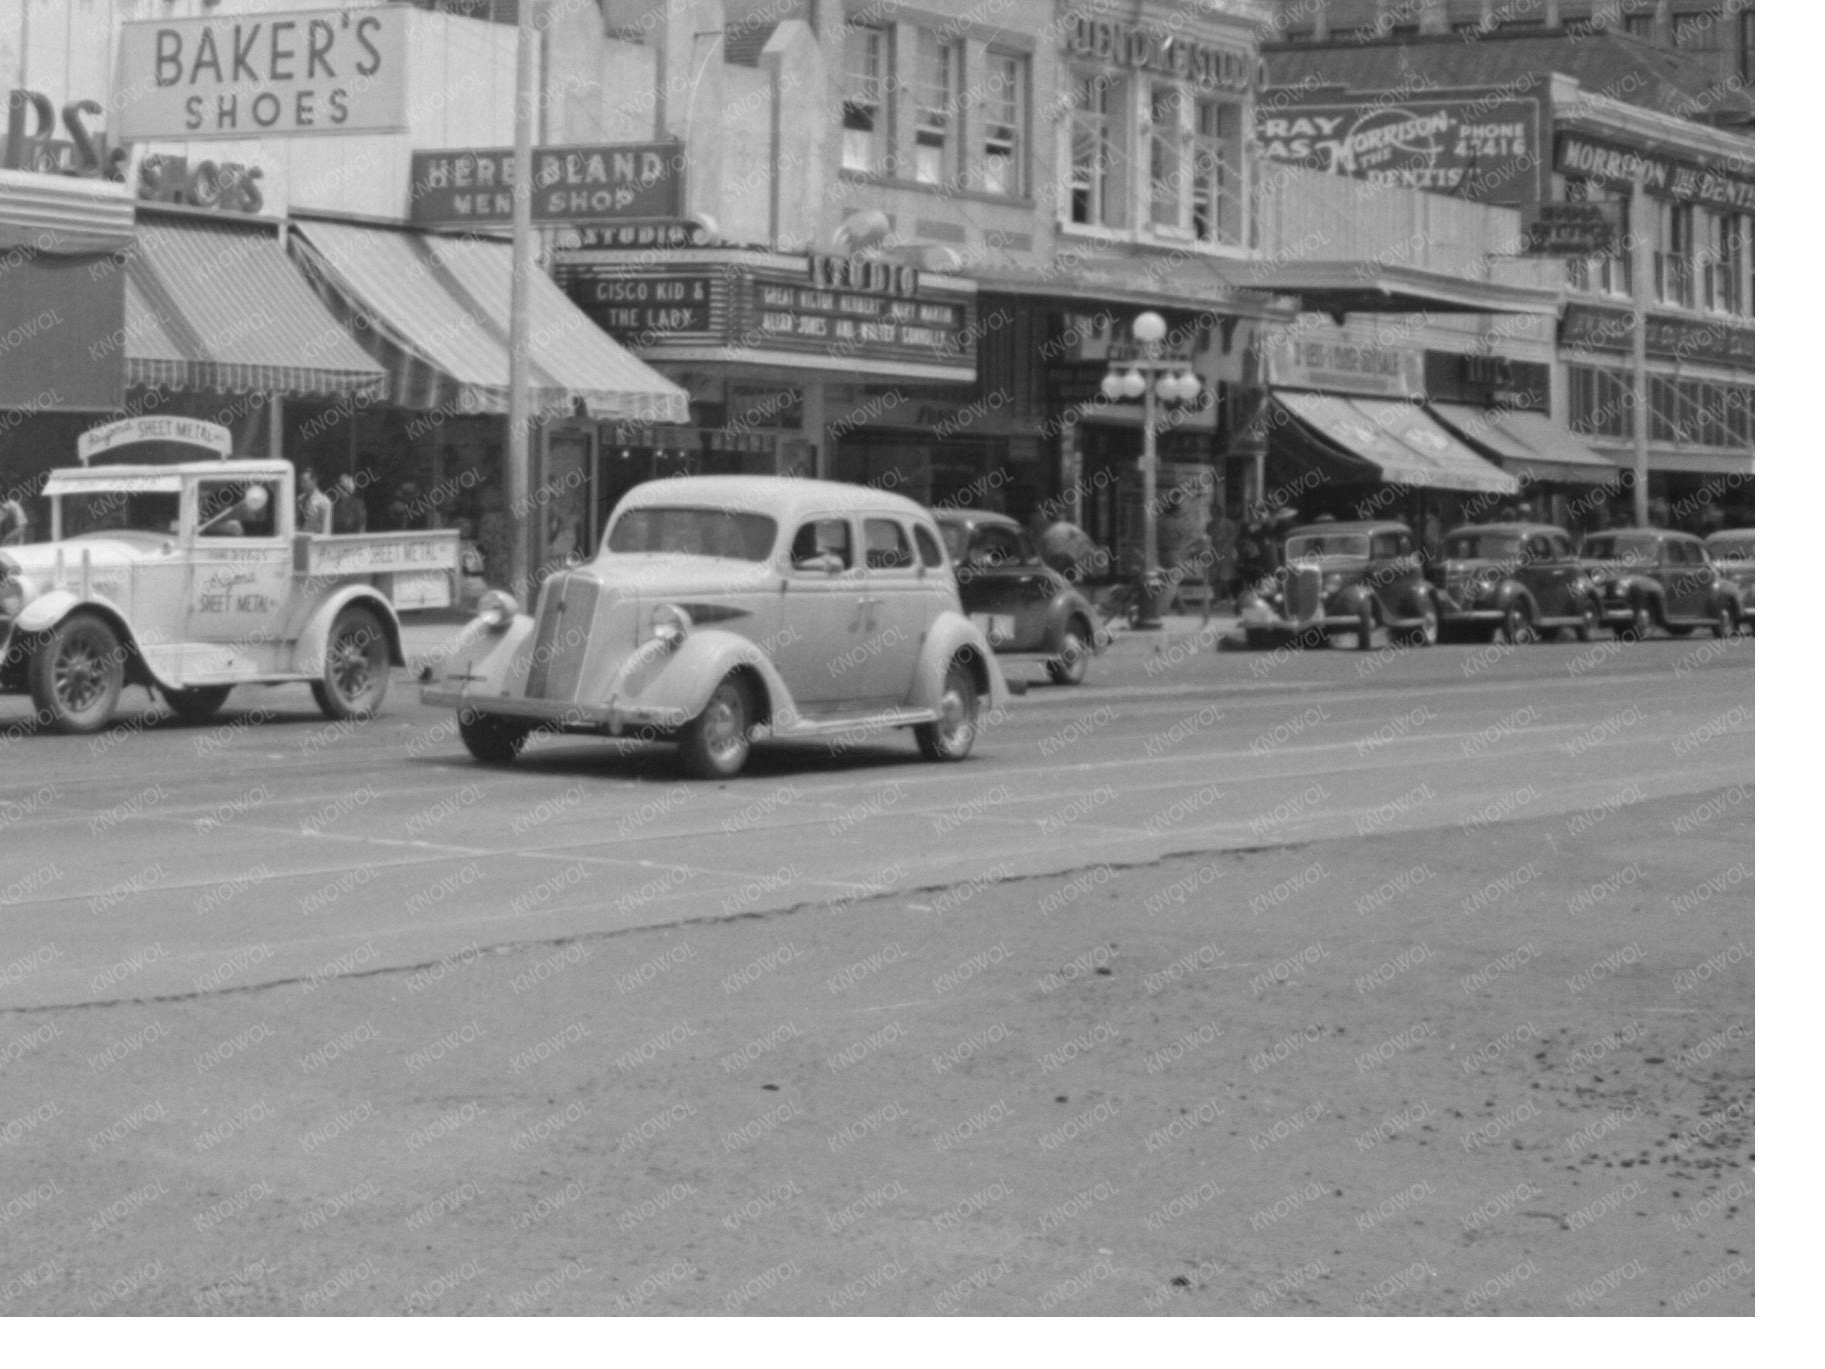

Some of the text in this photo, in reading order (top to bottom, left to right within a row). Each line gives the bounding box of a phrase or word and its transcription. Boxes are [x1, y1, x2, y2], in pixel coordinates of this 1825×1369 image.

[154, 11, 382, 87] BAKER'S
[184, 88, 349, 130] SHOES
[1459, 122, 1526, 139] PHONE
[541, 151, 663, 185] BLAND
[1358, 146, 1394, 168] THE
[1564, 140, 1670, 188] MORRISON
[547, 189, 635, 213] SHOP
[582, 225, 686, 245] STUDIO
[810, 253, 919, 298] STUDIO
[596, 280, 705, 301] CISCO KID &
[763, 286, 794, 306] GREAT
[799, 290, 834, 311] VICTOR
[609, 307, 693, 327] THE LADY
[762, 311, 794, 332] ALLAN
[798, 314, 827, 336] JONES
[835, 319, 854, 338] AND
[859, 322, 895, 343] WALTER
[137, 419, 173, 439] SHEET
[176, 420, 214, 443] METAL
[368, 542, 401, 564] SHEET
[403, 540, 438, 562] METAL
[199, 593, 233, 613] SHEET
[236, 593, 269, 613] METAL
